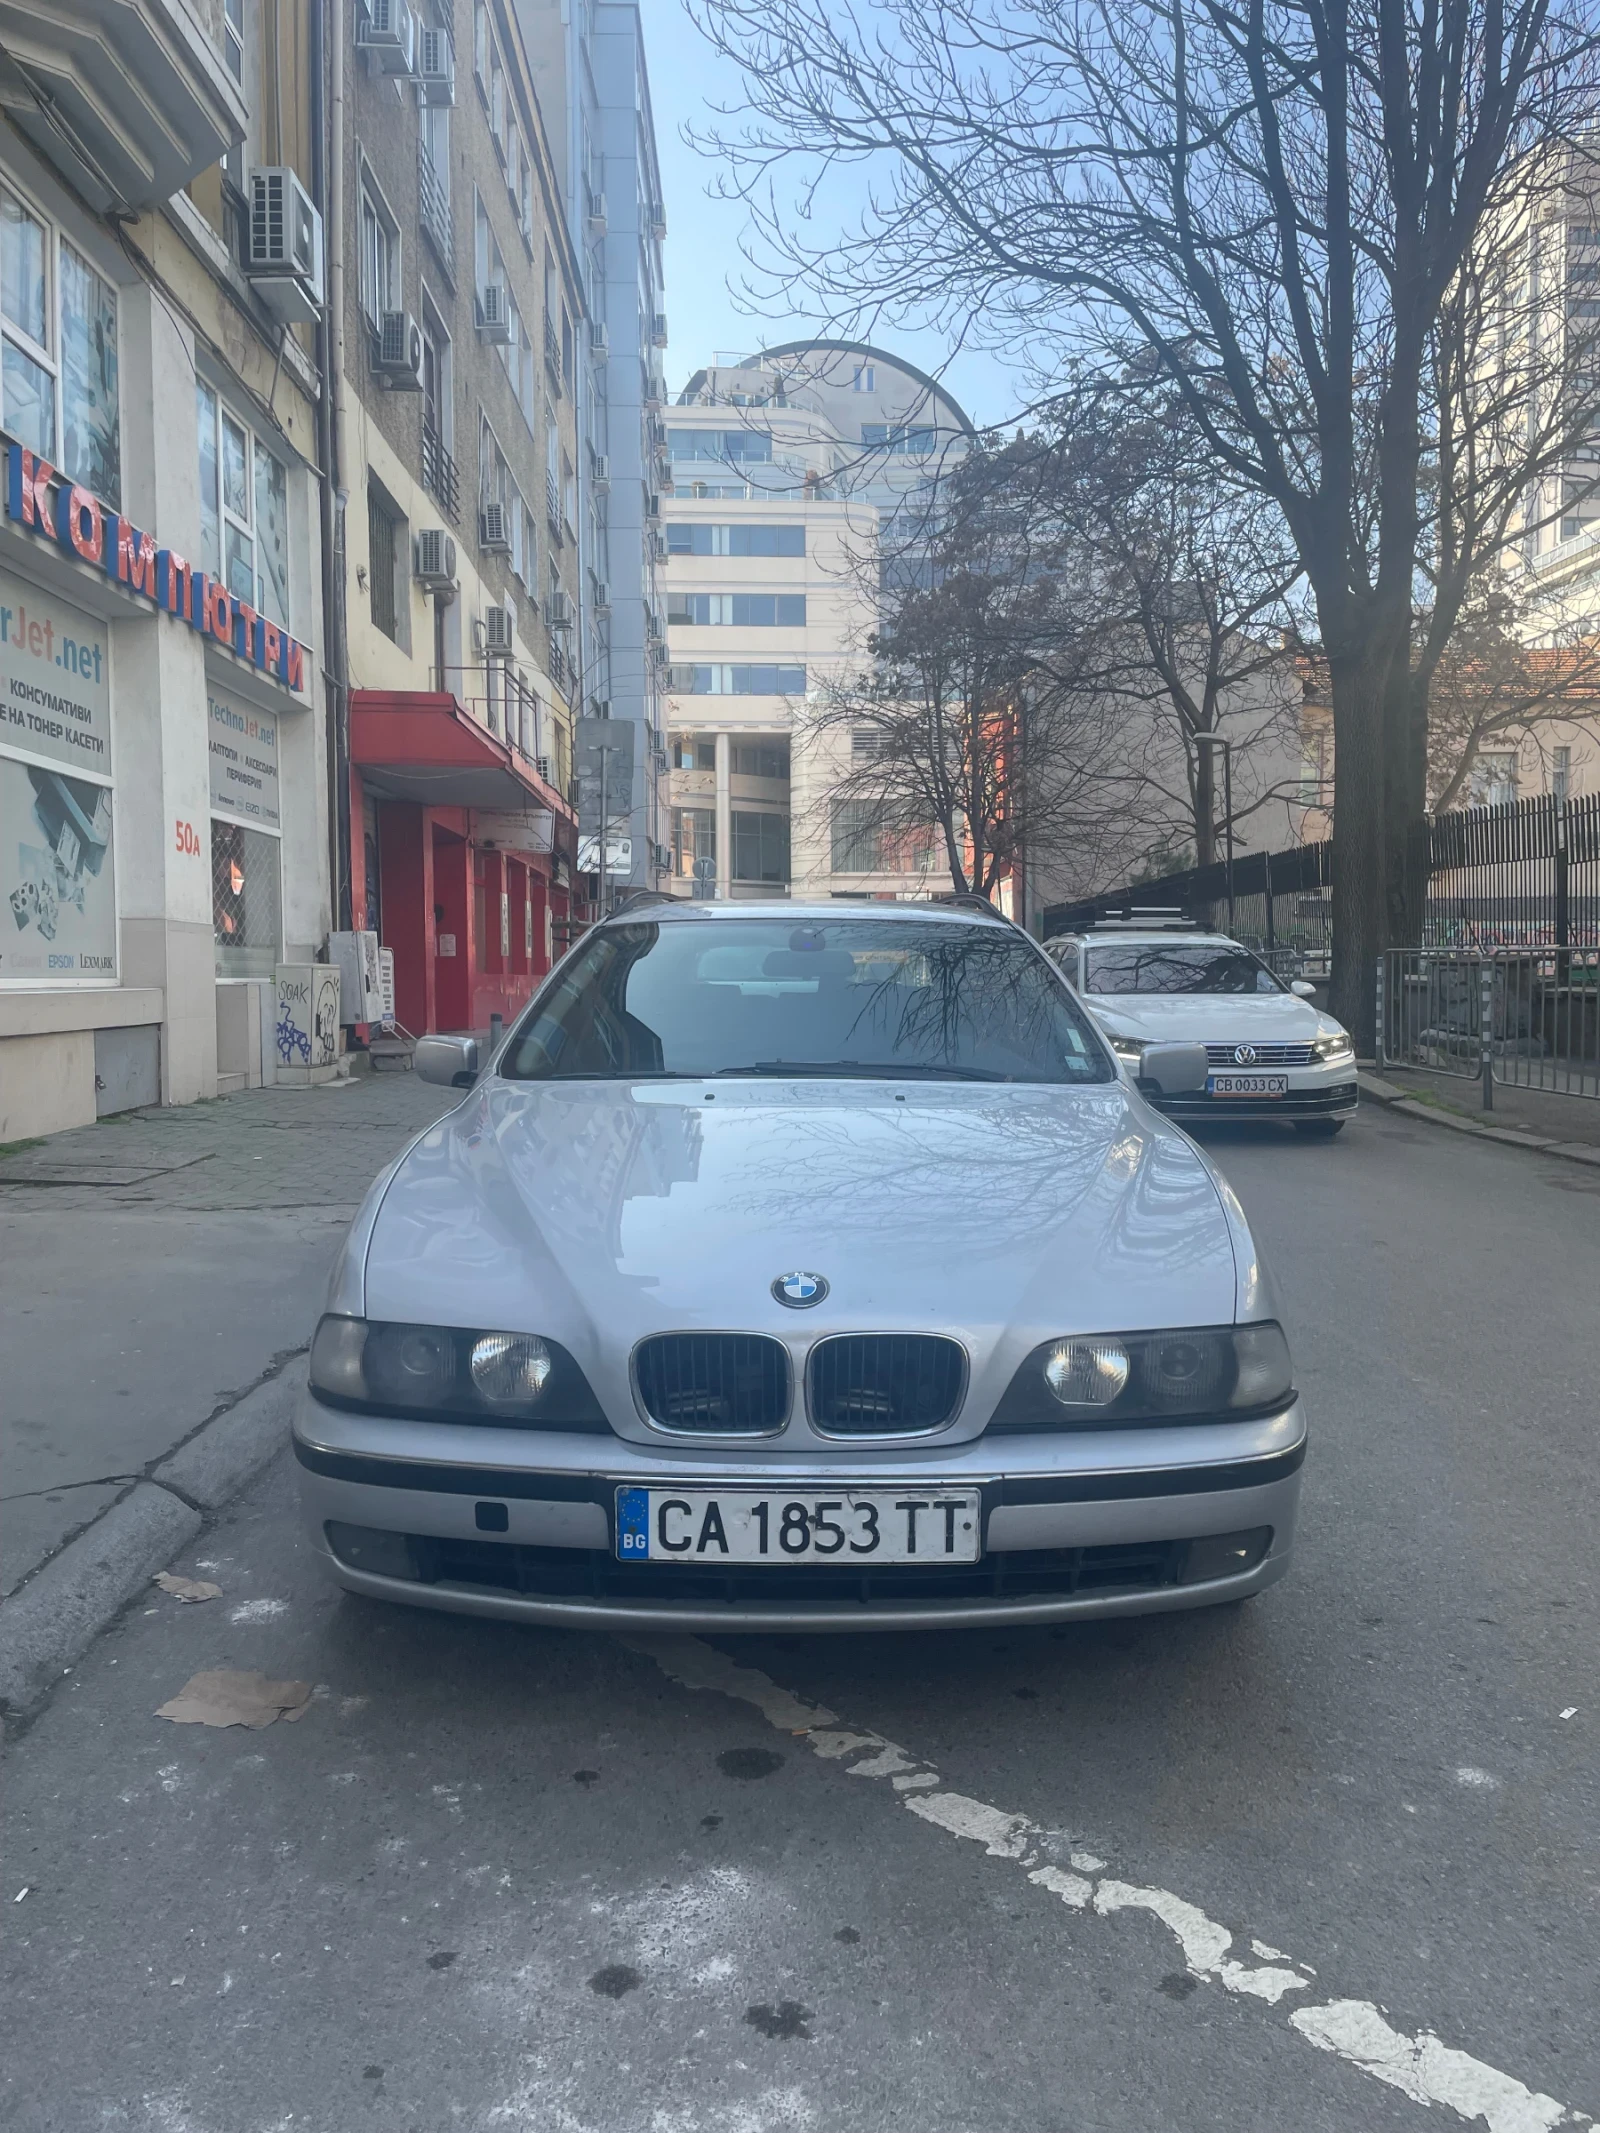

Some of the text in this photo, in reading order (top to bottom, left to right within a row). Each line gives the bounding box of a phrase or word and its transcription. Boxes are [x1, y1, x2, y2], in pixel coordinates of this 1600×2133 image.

[9, 445, 304, 692] КОМПЮТРИ
[10, 678, 92, 724] КОНСУМАТИВИ
[208, 697, 275, 747] TechnoJet.net
[9, 706, 26, 727] НА
[27, 713, 63, 739] ТОНЕР
[66, 727, 104, 754] КАСЕТИ
[209, 740, 238, 762] ЛАПТОПИ
[48, 954, 74, 969] EPSON
[1216, 1078, 1285, 1092] CB 0033 CX
[623, 1533, 646, 1550] BG
[658, 1499, 967, 1555] CA 1853 TT
